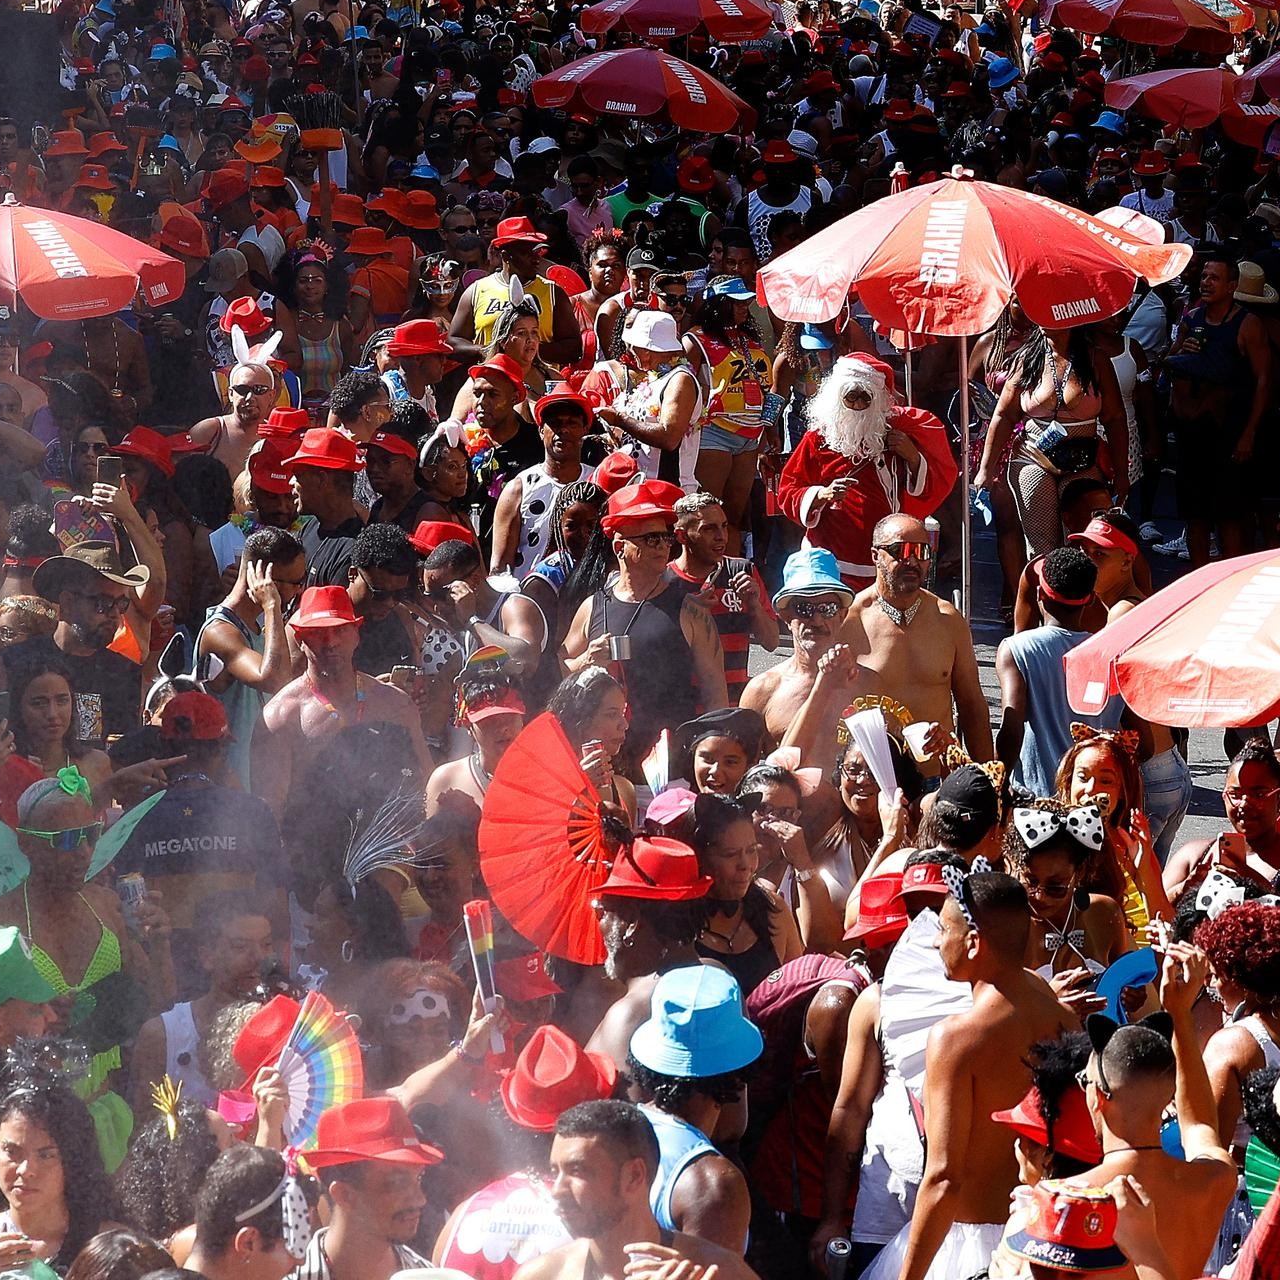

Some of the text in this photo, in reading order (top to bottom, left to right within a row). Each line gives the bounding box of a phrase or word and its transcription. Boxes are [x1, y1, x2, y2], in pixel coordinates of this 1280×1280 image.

[649, 27, 676, 36] BRAHMA
[664, 58, 708, 105] BRAHMA
[605, 100, 637, 113] BRAHMA
[22, 220, 89, 280] BRAHMA
[920, 199, 969, 286] BRAHMA
[1051, 297, 1102, 321] BRAHMA
[144, 835, 237, 857] MEGATONE
